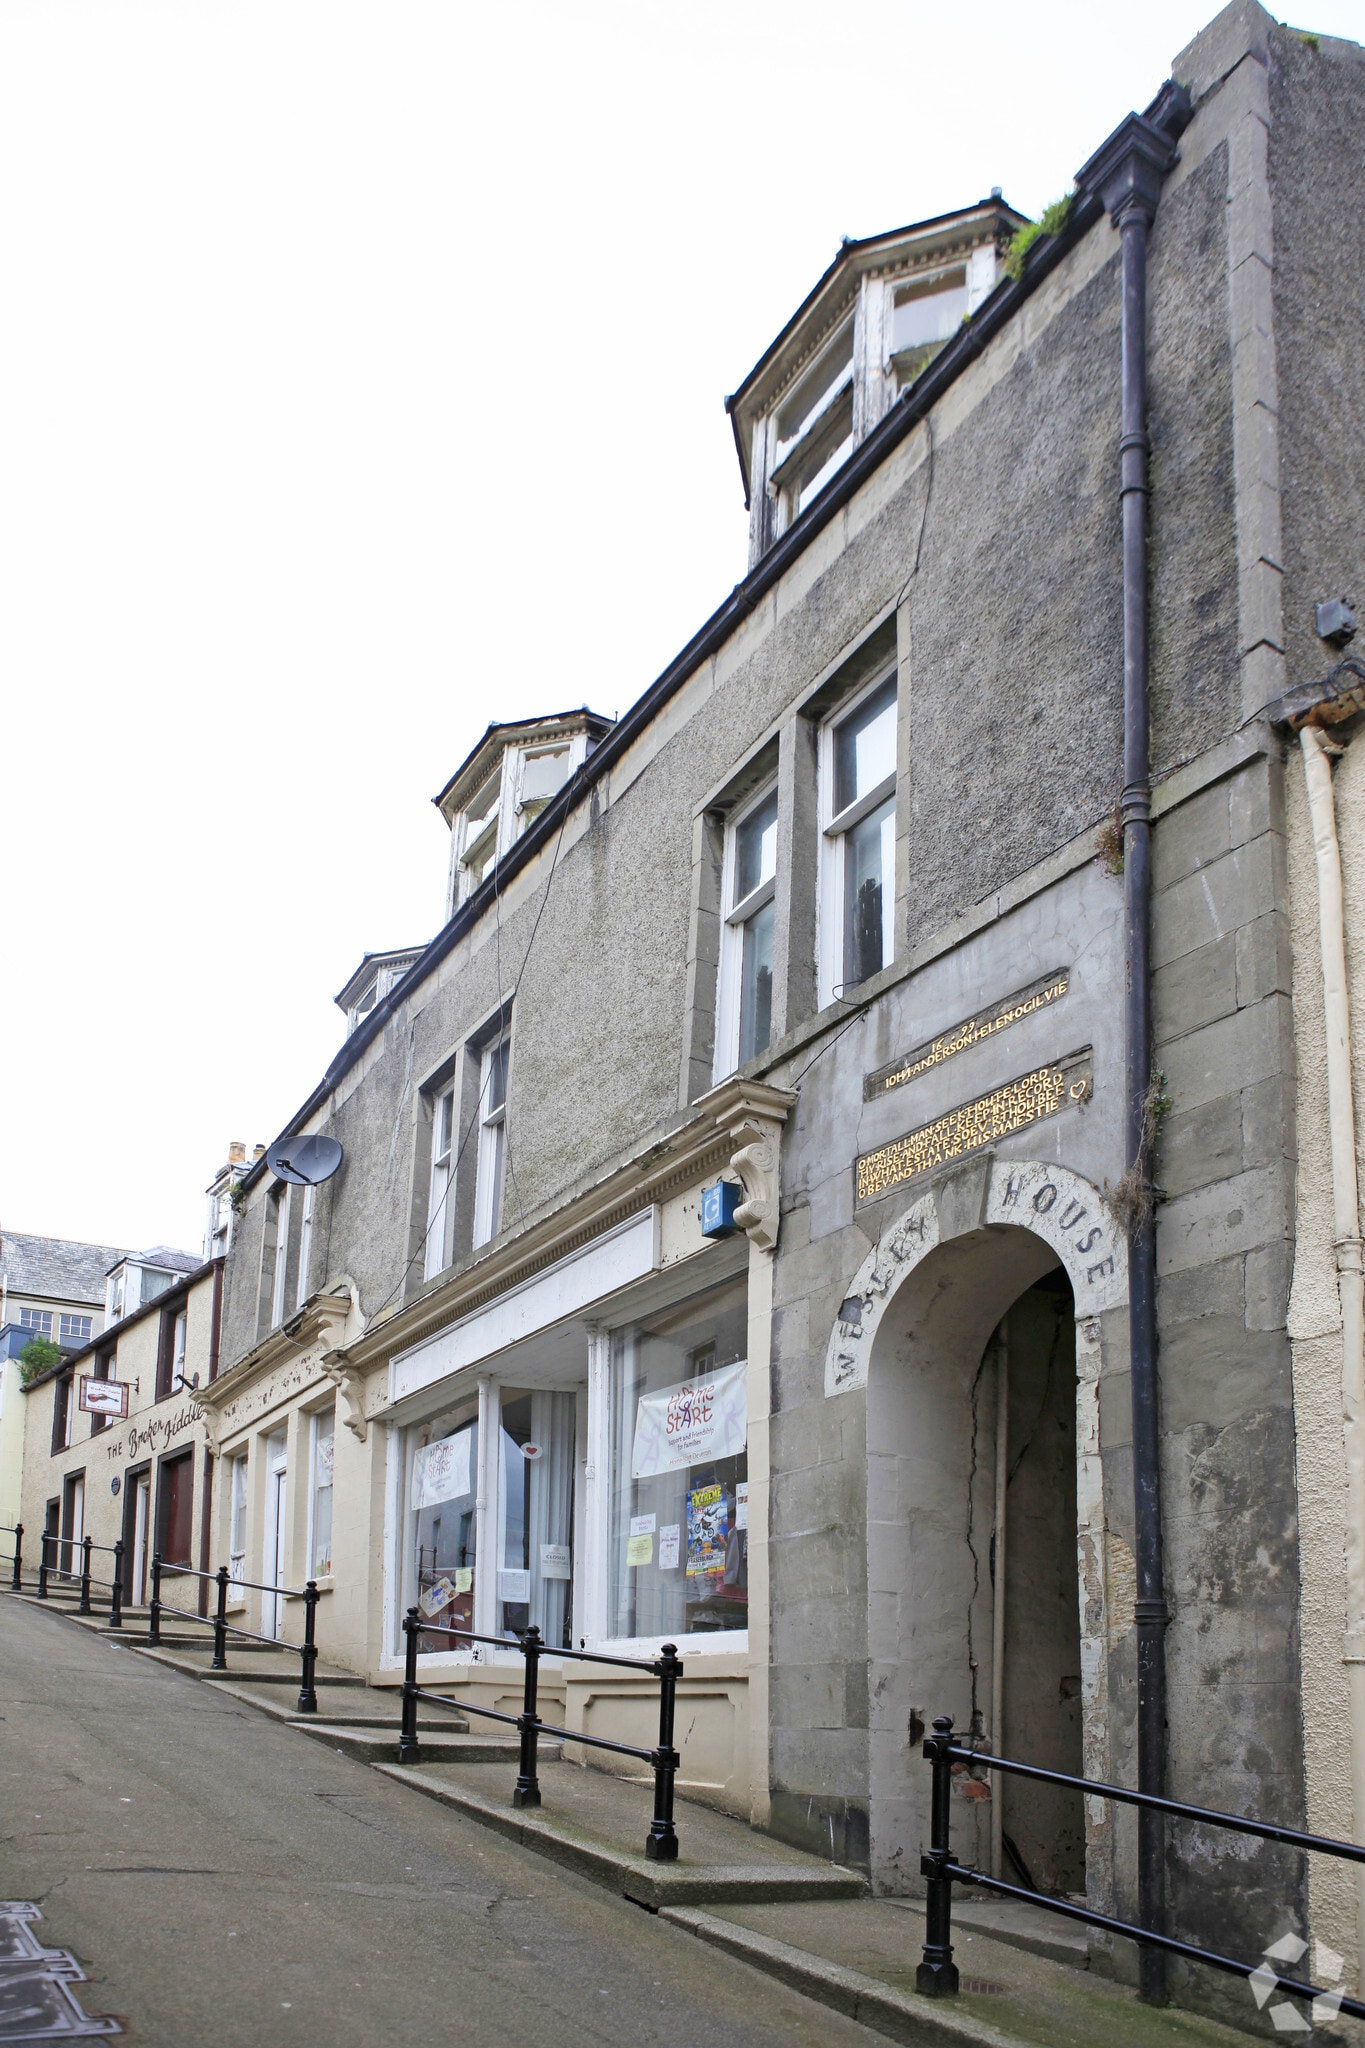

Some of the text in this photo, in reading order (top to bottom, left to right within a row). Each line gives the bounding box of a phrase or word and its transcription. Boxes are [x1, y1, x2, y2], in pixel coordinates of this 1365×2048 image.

[913, 1034, 973, 1075] ANDERSON
[1002, 1172, 1116, 1286] HOUSE
[107, 1441, 123, 1460] THE
